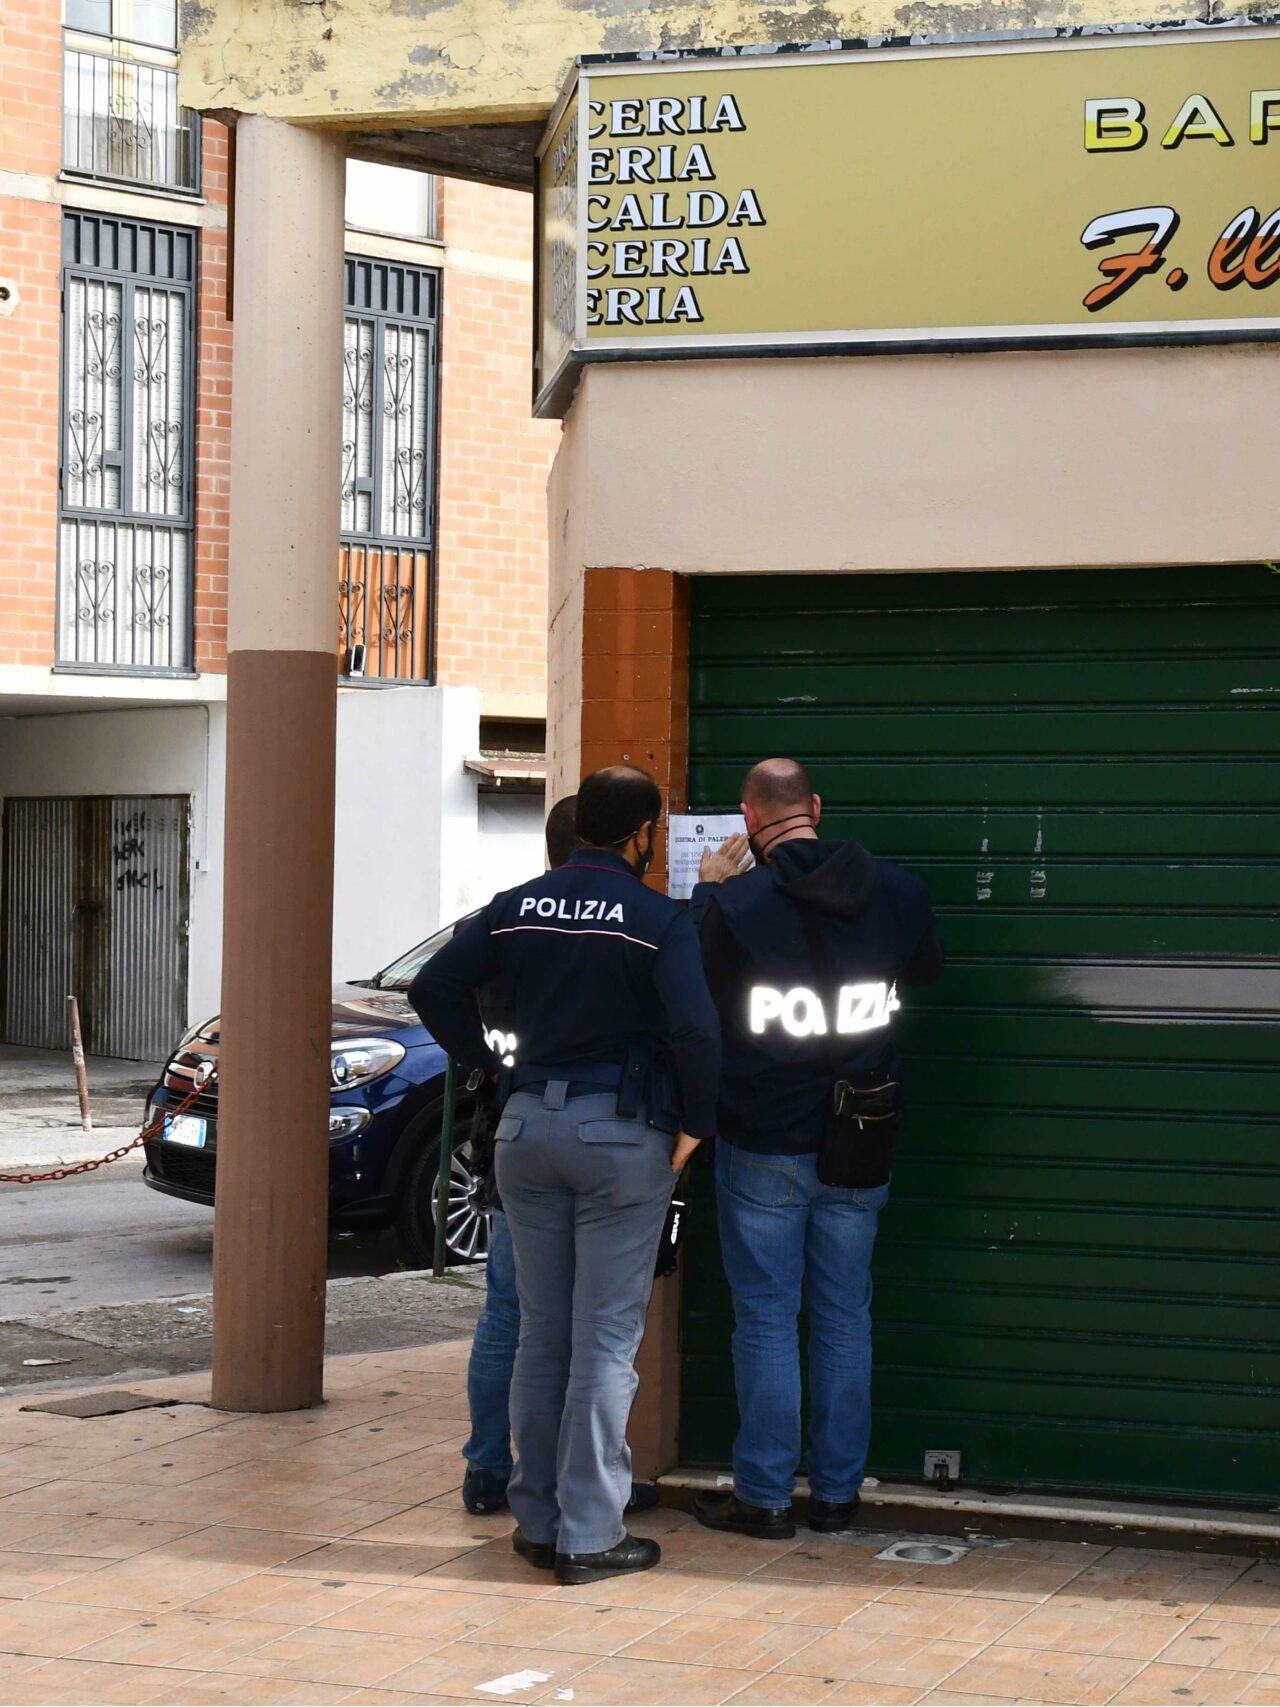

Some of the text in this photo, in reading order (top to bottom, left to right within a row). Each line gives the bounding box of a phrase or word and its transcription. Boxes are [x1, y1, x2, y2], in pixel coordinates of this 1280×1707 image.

[588, 143, 716, 185] ERIA
[587, 188, 767, 233] CALDA
[587, 237, 750, 279] CERIA
[519, 897, 625, 922] POLIZIA
